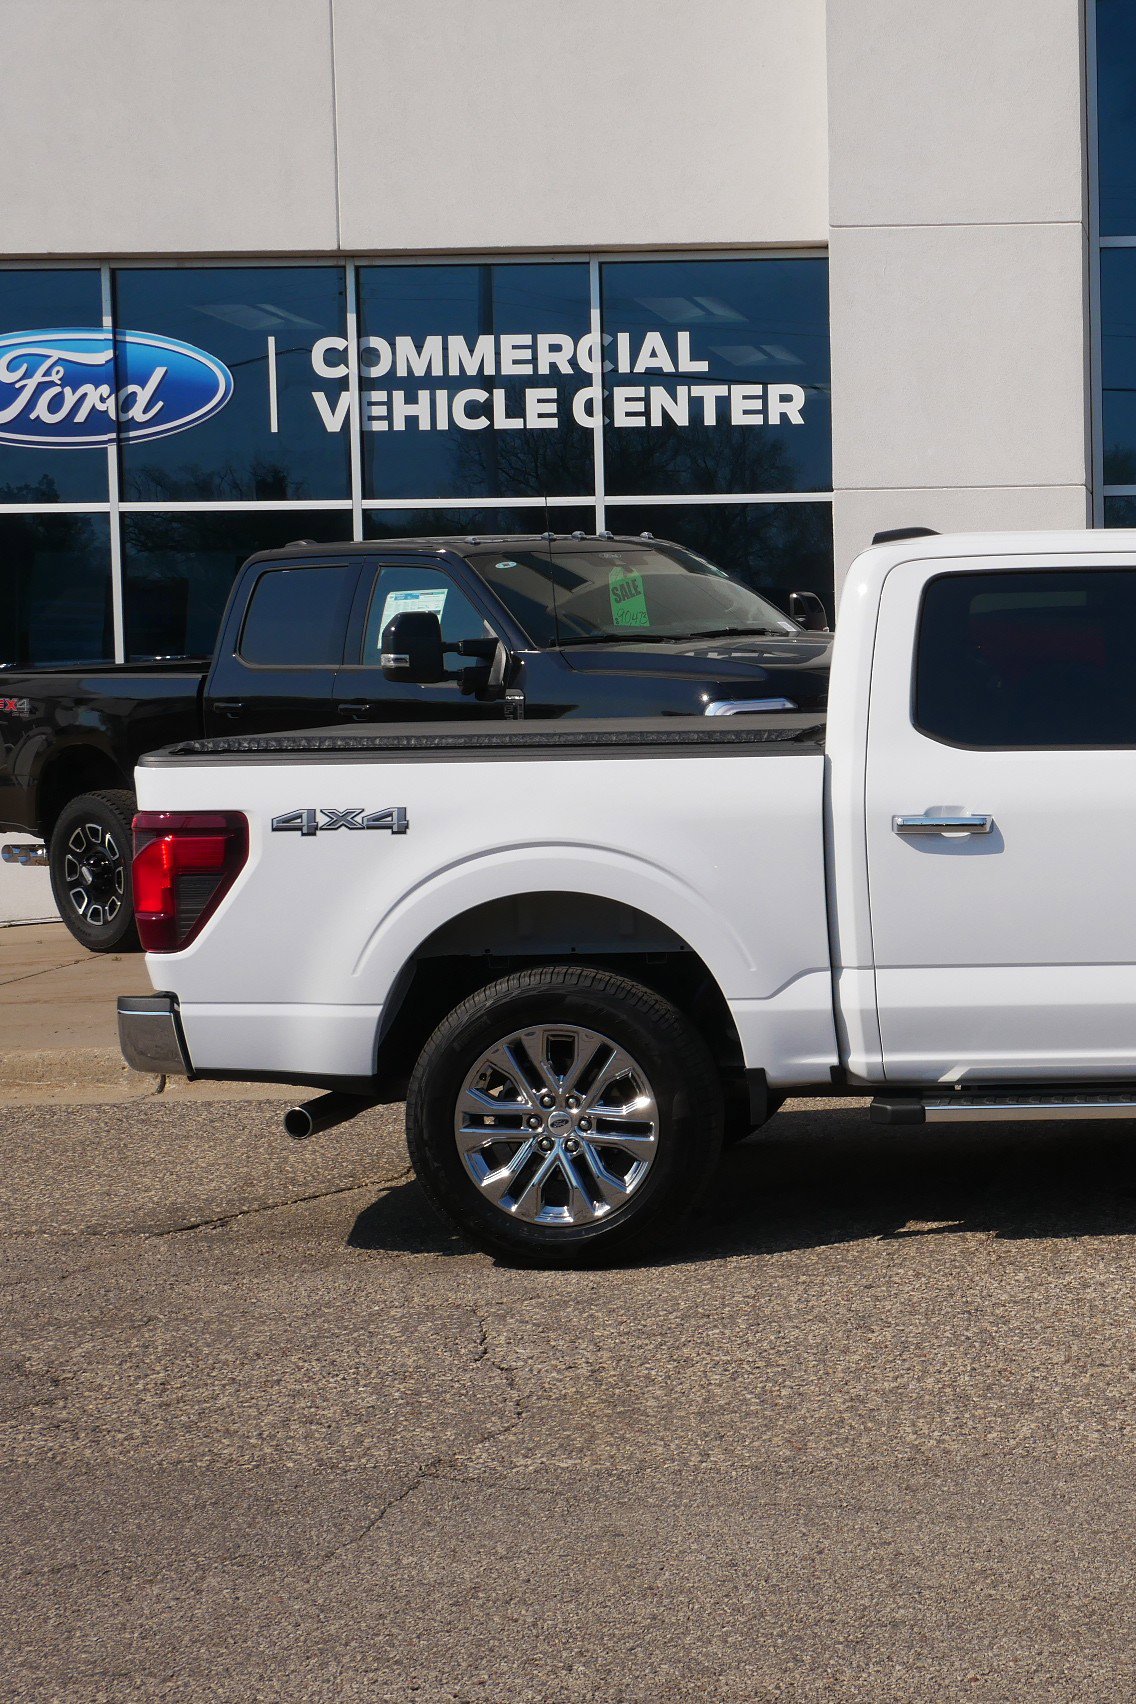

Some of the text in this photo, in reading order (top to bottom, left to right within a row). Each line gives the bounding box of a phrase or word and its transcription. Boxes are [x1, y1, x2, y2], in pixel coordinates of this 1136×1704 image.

[311, 331, 709, 378] COMMERCIAL
[0, 347, 167, 424] Ford
[311, 384, 806, 432] VEHICLE CENTER
[611, 578, 642, 604] SALE
